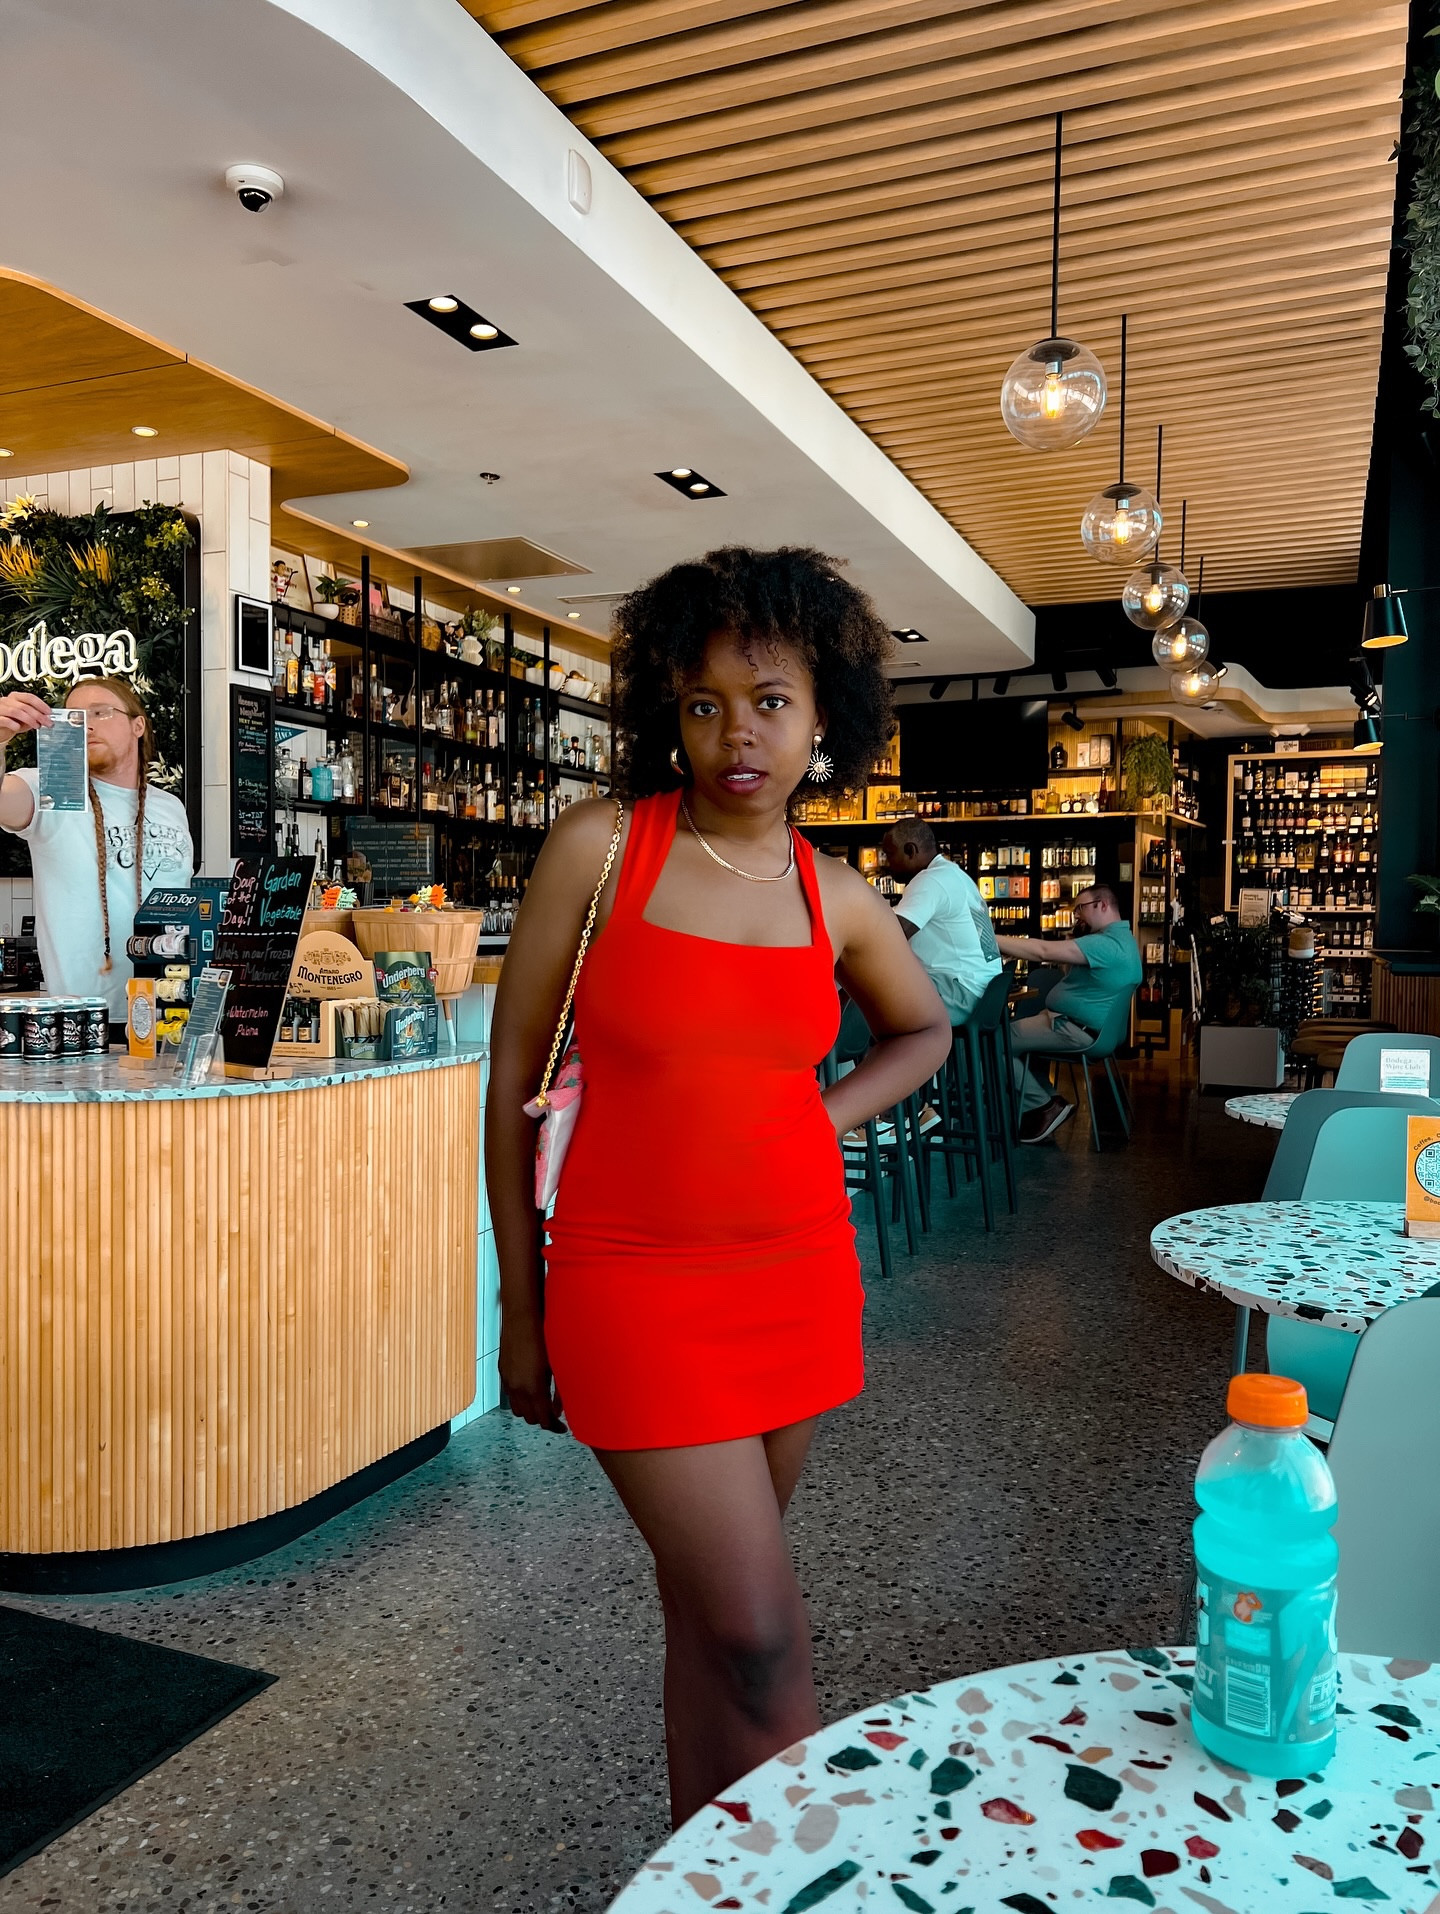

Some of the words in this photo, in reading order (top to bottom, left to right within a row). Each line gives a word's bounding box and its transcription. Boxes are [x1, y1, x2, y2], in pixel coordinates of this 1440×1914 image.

[233, 861, 256, 893] Soup
[263, 864, 302, 892] Garden
[161, 893, 178, 906] Tip
[177, 893, 197, 906] Top
[227, 891, 237, 905] of
[237, 891, 251, 904] the
[260, 896, 302, 927] Vegetable
[297, 965, 363, 985] MONTENEGRO
[382, 966, 426, 989] Underberg
[229, 1005, 269, 1018] Watermelon
[235, 1023, 259, 1037] Paloma
[395, 1010, 425, 1035] Underberg
